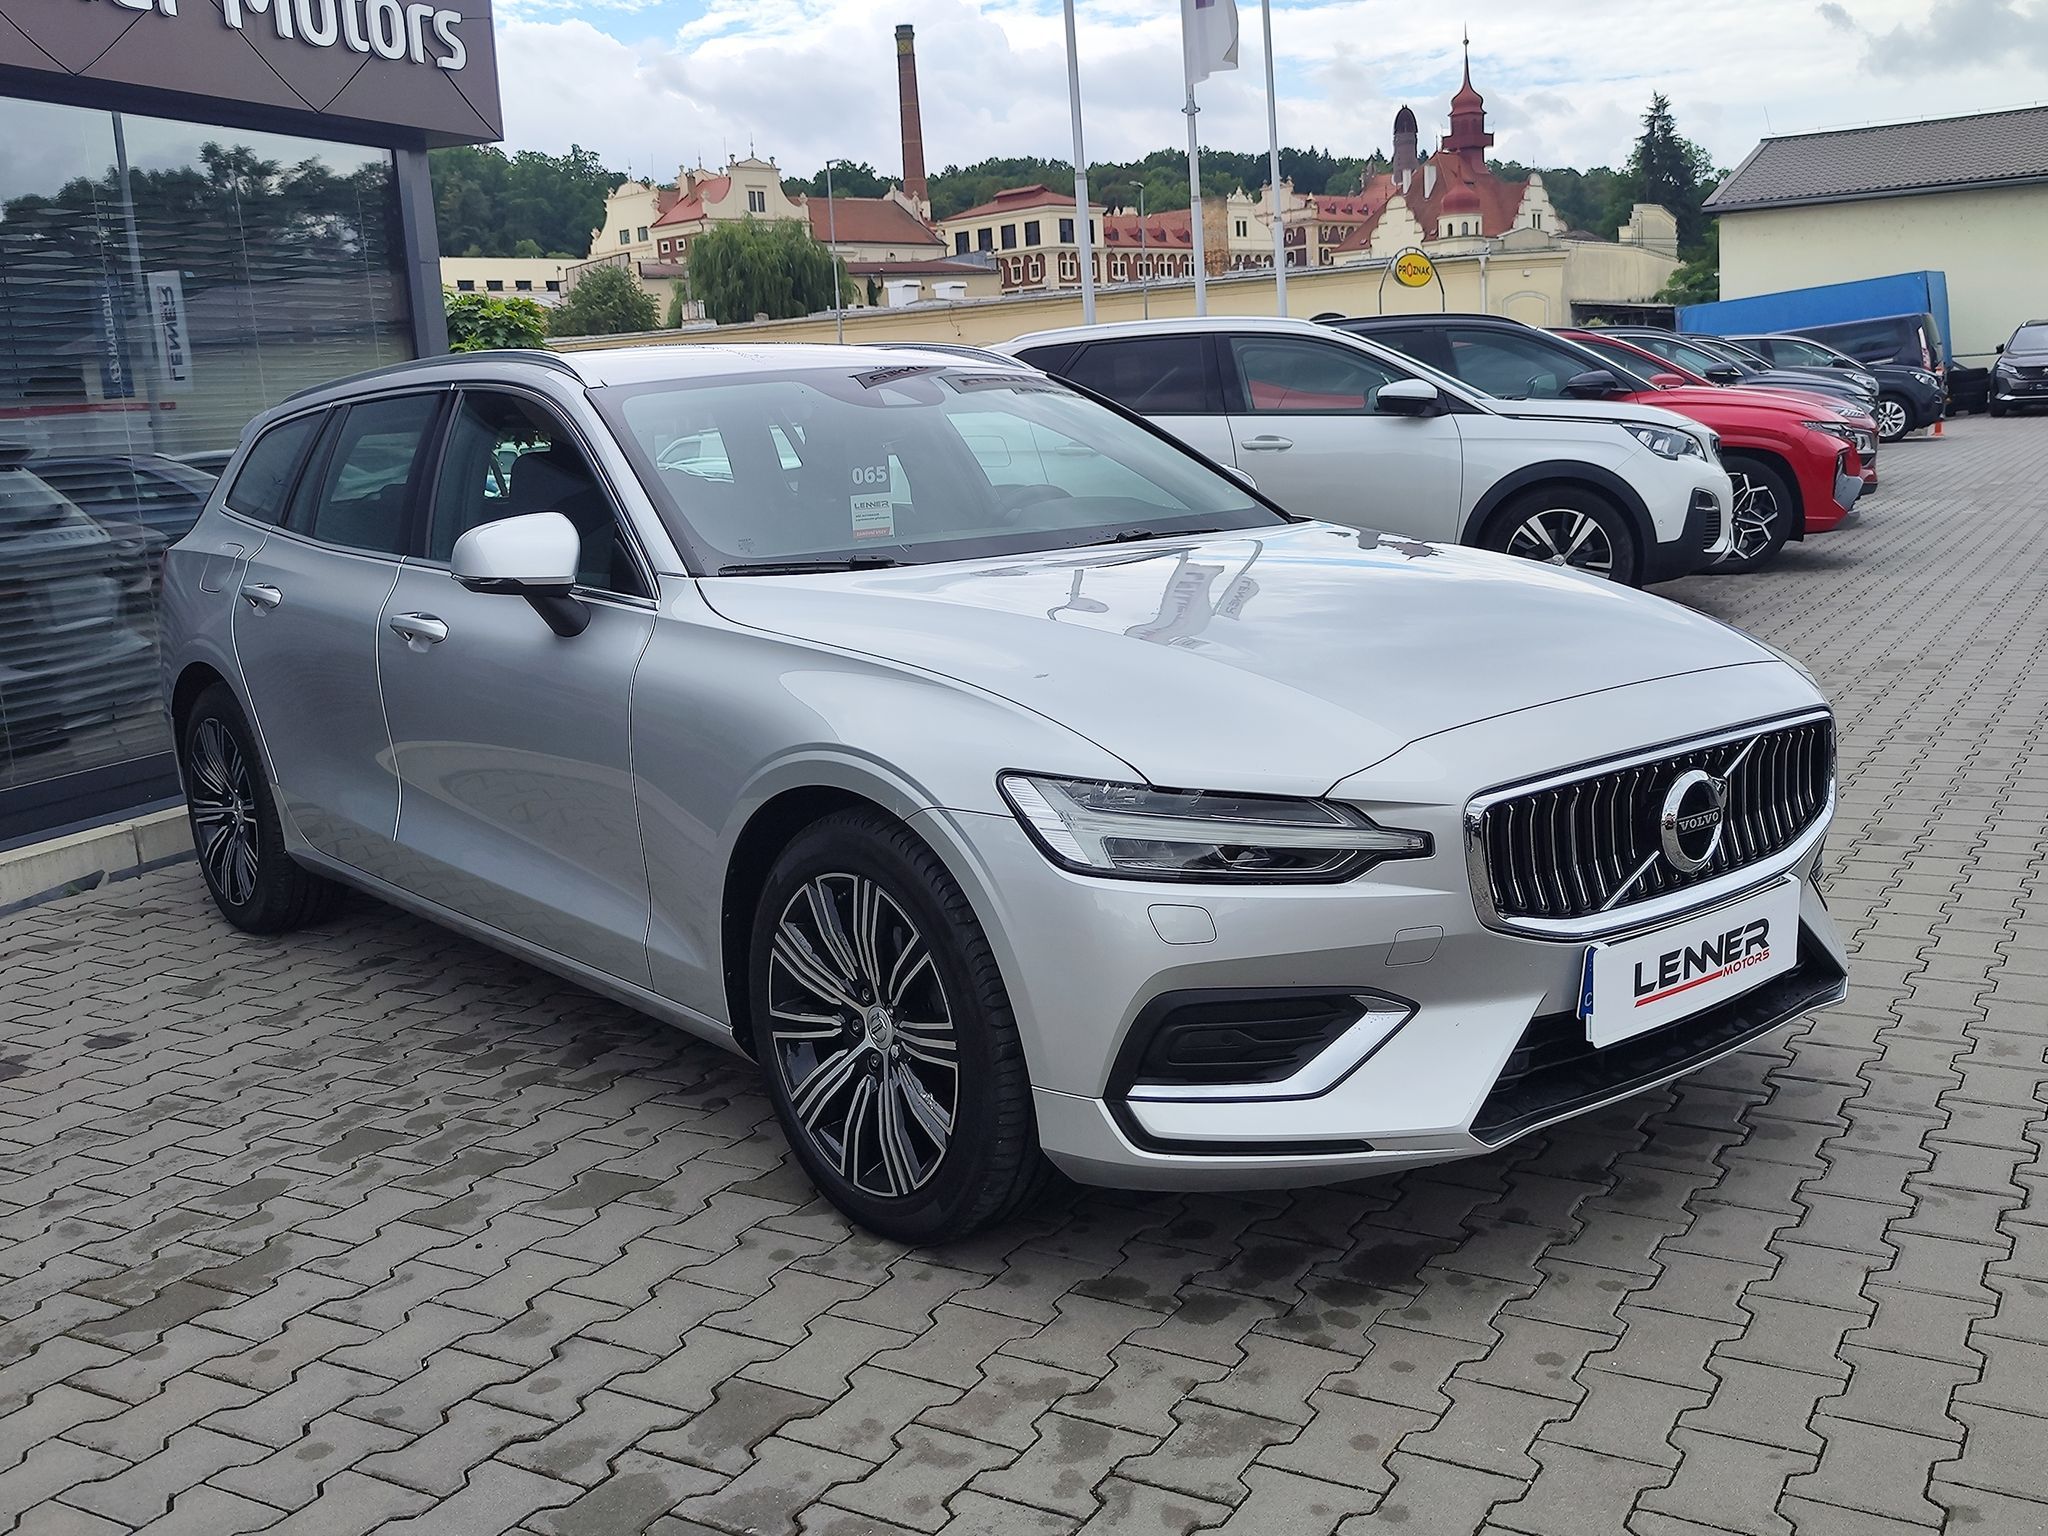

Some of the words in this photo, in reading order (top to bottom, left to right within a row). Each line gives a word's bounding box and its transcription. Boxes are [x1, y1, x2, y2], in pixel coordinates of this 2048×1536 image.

[1398, 262, 1430, 277] PROZNAK
[852, 465, 887, 485] 065
[1679, 811, 1719, 831] VOLVO
[1634, 918, 1769, 997] LENNER
[1723, 948, 1770, 977] MOTORS
